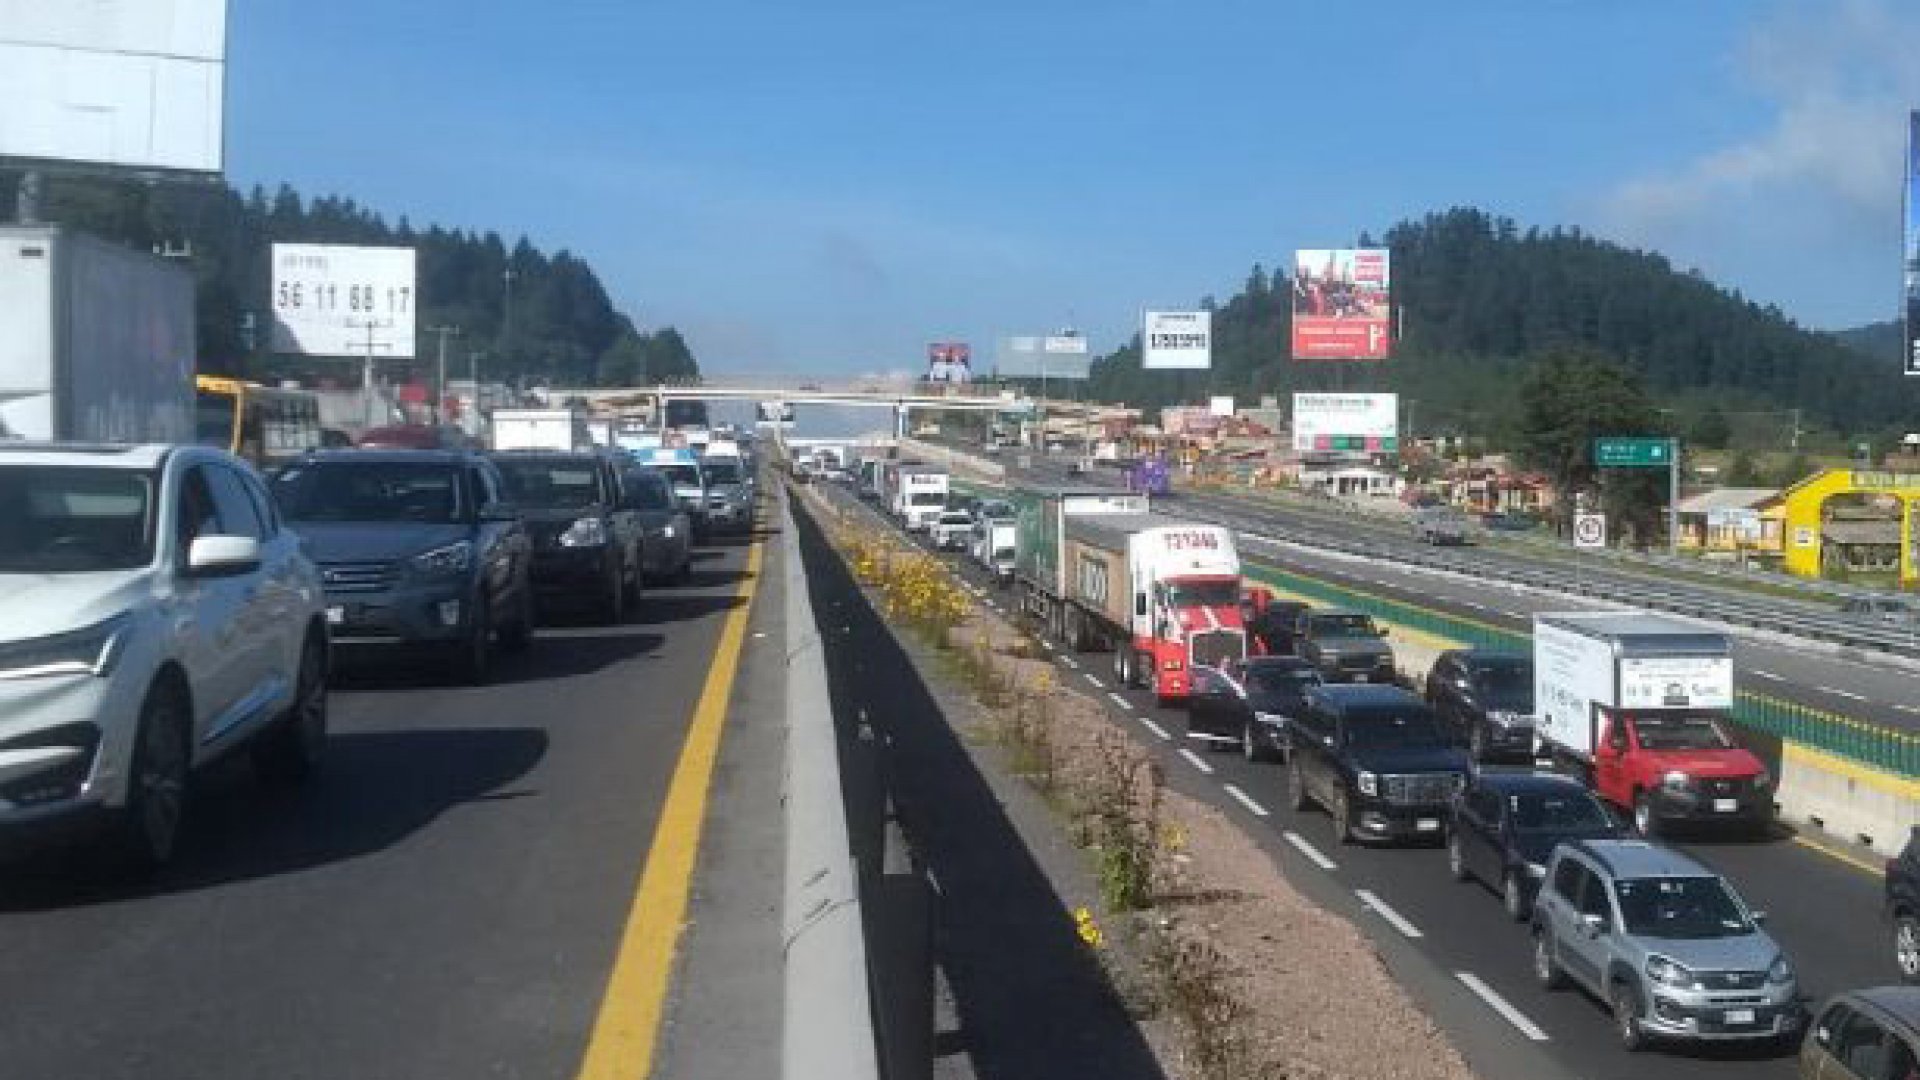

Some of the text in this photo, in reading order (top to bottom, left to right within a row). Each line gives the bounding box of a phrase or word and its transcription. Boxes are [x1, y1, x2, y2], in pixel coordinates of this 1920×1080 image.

[278, 281, 303, 309] 56
[315, 283, 337, 310] 11
[387, 286, 410, 313] 17
